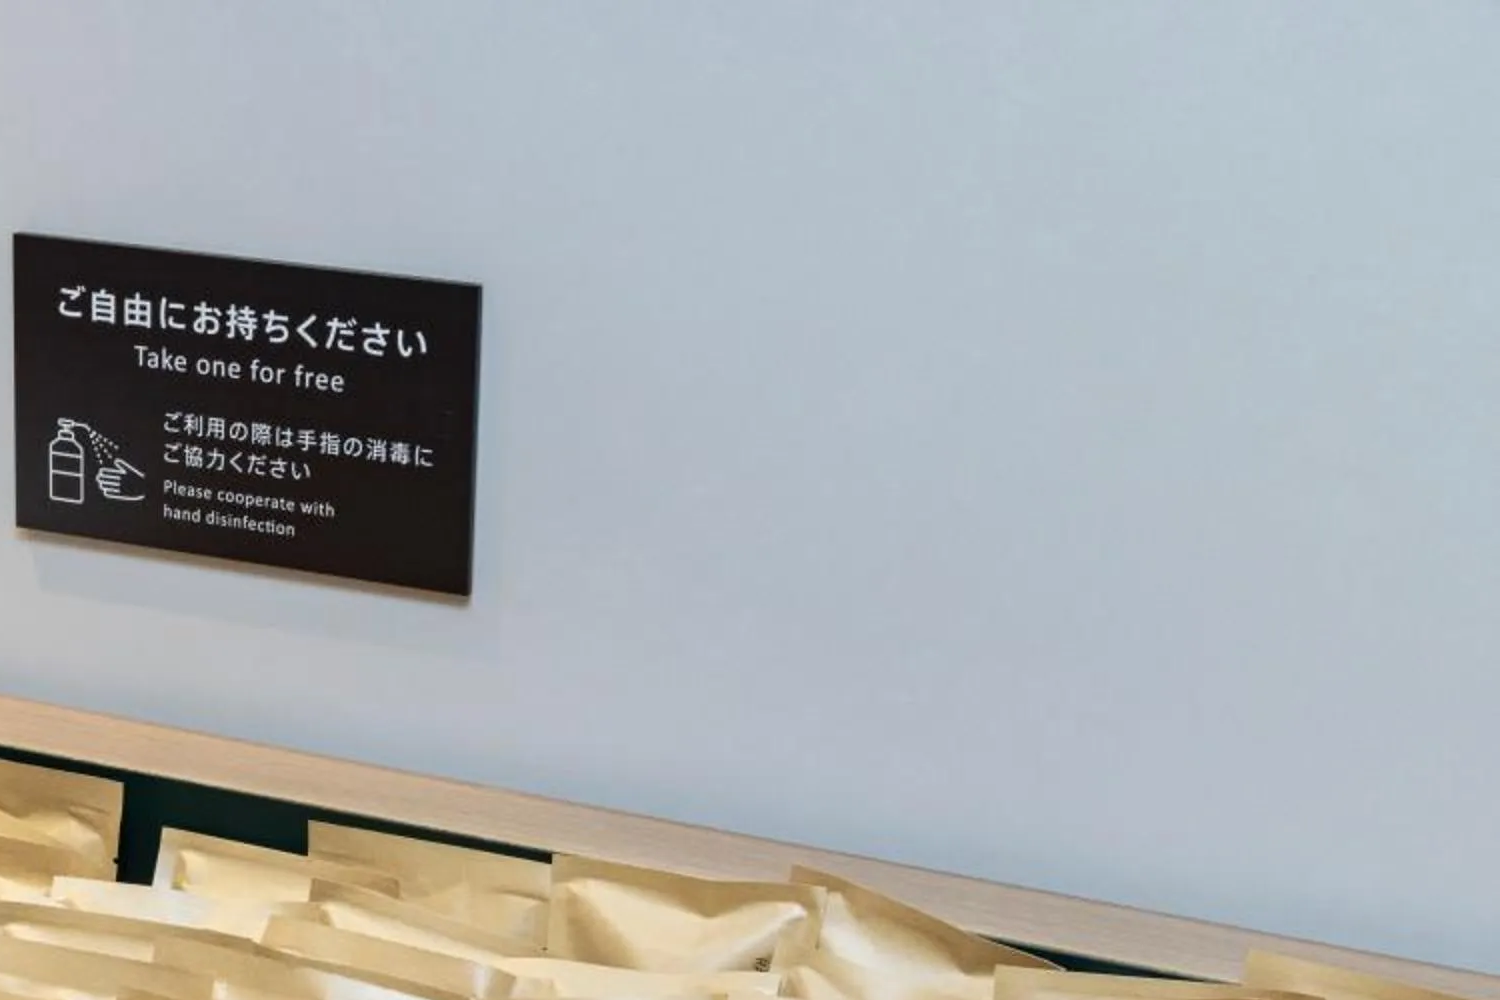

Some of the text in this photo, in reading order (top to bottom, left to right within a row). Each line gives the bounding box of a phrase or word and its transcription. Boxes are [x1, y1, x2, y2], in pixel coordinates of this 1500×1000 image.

[57, 284, 428, 358] ご自由にお持ちください
[133, 344, 346, 393] Take one for free
[163, 411, 435, 468] ご利用の際は手指の消毒に
[163, 443, 312, 481] ご協力ください
[163, 479, 336, 518] Please cooperate with
[163, 503, 296, 537] hand disinfection
